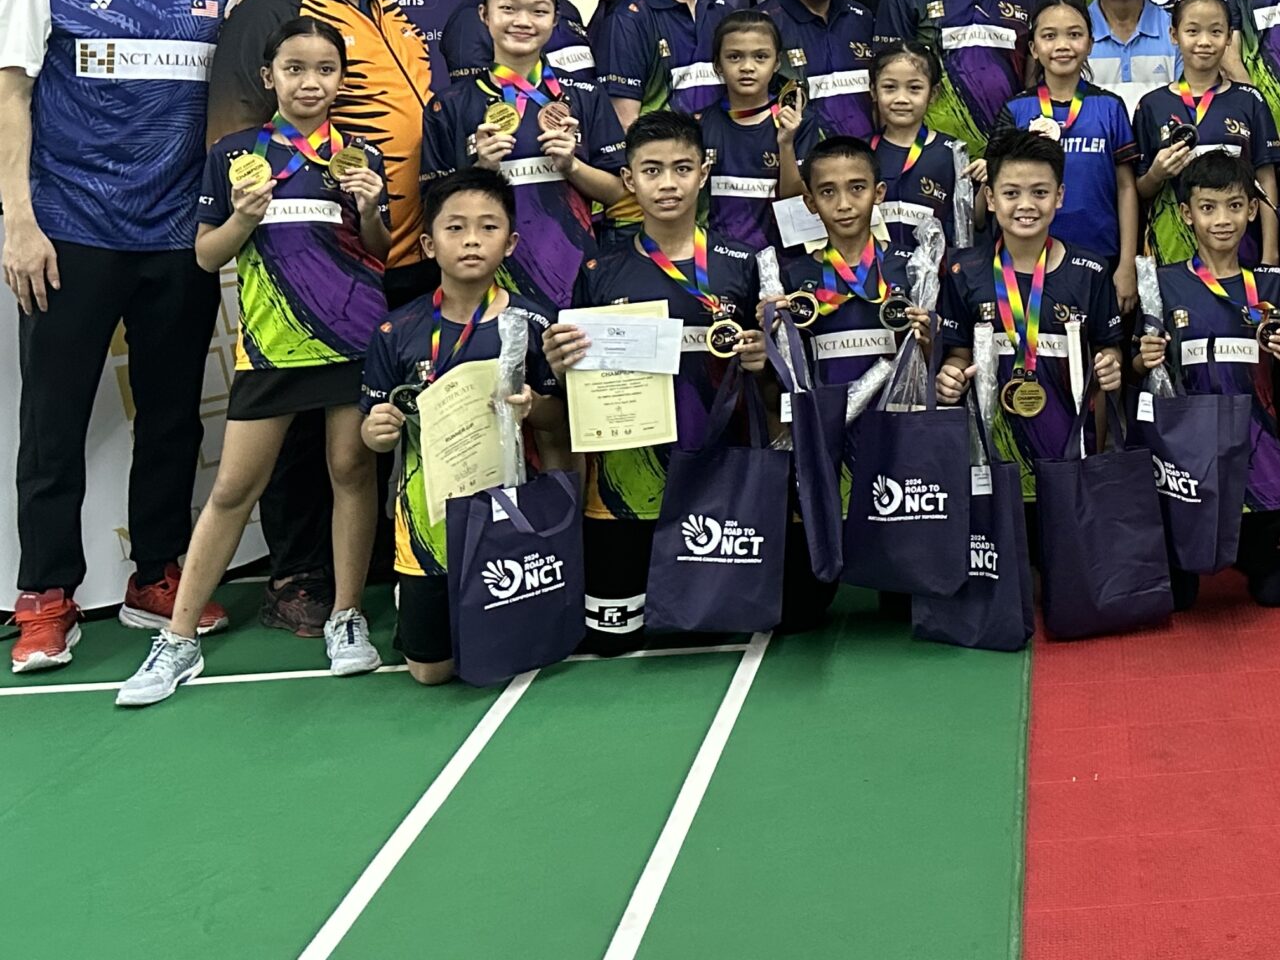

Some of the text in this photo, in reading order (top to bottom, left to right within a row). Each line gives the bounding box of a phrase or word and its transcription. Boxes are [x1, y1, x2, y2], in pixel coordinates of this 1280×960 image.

[1015, 12, 1029, 21] NCT
[949, 31, 1012, 42] NCT ALLIANCE
[119, 53, 151, 65] NCT
[628, 78, 642, 86] NCT
[280, 206, 336, 216] ALLIANCE
[714, 245, 749, 260] ULTRON
[1072, 257, 1103, 272] ULTRON
[800, 309, 812, 317] NCT
[1070, 313, 1088, 323] NCT
[943, 318, 959, 329] NCT
[818, 337, 890, 351] NCT ALLIANCE
[1188, 345, 1254, 356] NCT LLIANCE
[370, 390, 387, 398] NCT
[1164, 461, 1175, 469] 2024
[1166, 468, 1180, 477] ROAD
[1166, 477, 1198, 497] NCT
[905, 493, 948, 512] NCT
[721, 537, 764, 555] NCT
[971, 541, 989, 550] ROAD
[524, 553, 539, 562] 2024
[971, 550, 998, 571] NCT
[524, 558, 545, 571] ROAD
[524, 561, 564, 591] NCT
